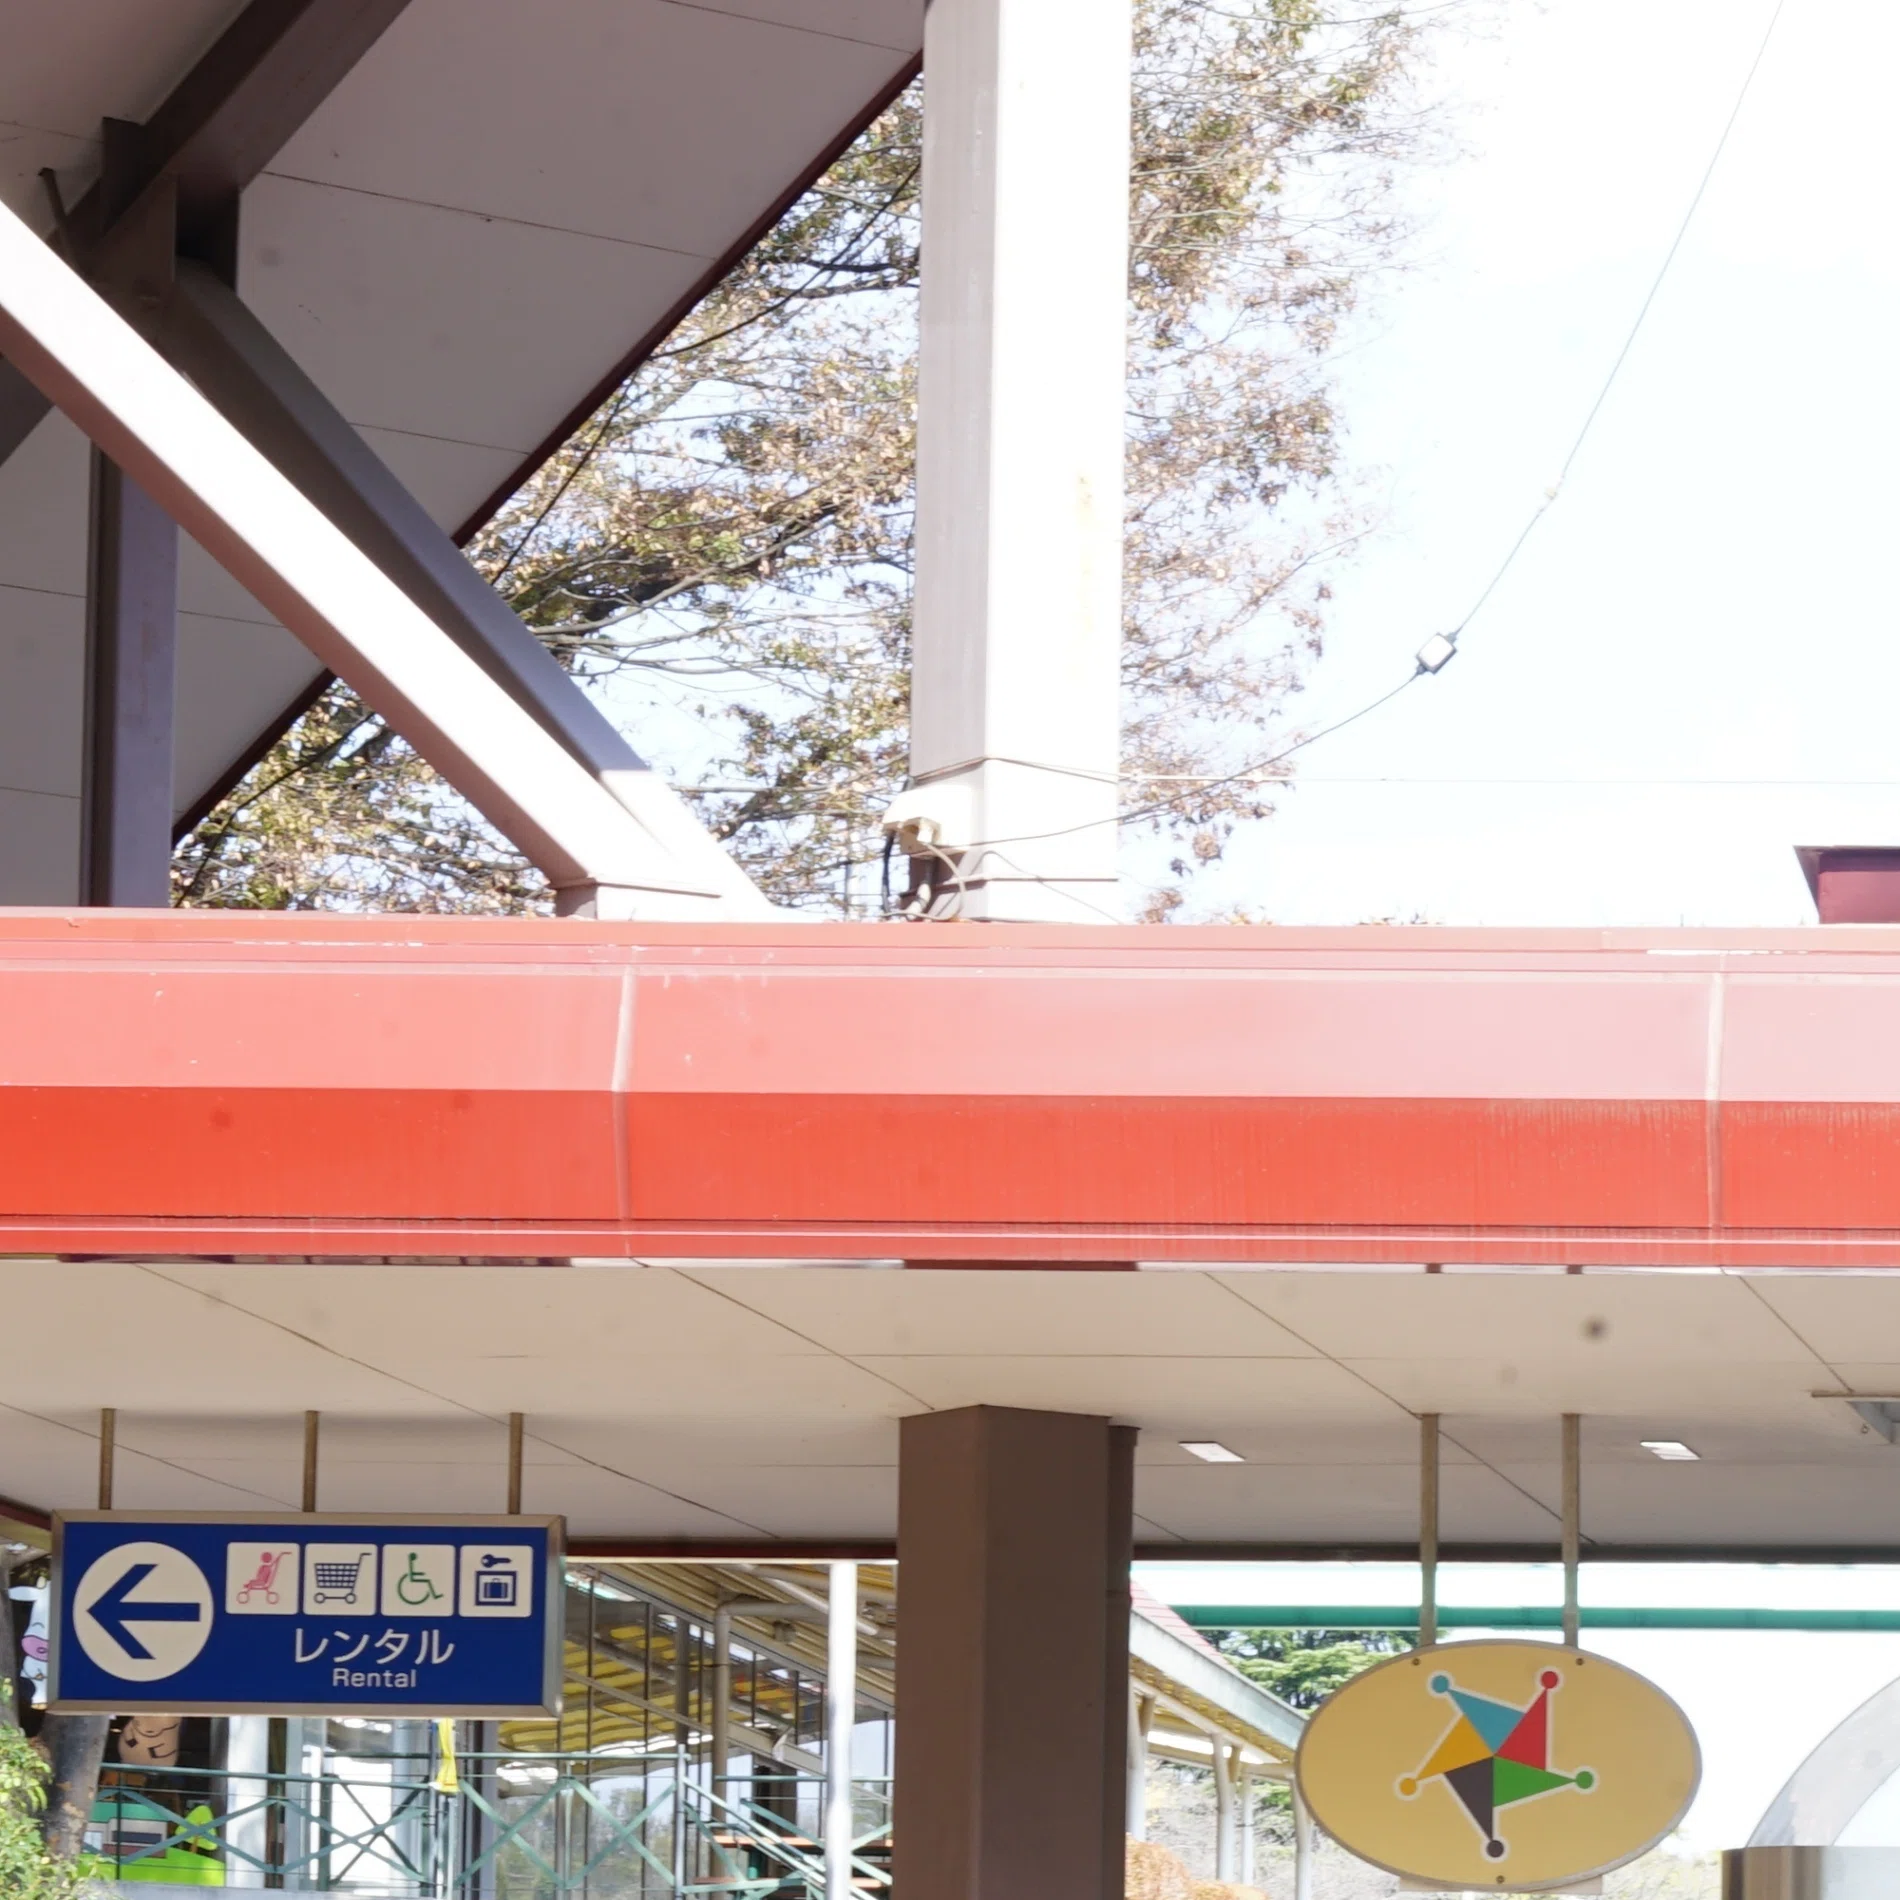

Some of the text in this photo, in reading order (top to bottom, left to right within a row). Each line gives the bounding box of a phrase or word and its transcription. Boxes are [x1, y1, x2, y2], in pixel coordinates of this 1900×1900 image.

[293, 1627, 455, 1666] レンタル
[332, 1667, 417, 1689] Rental
